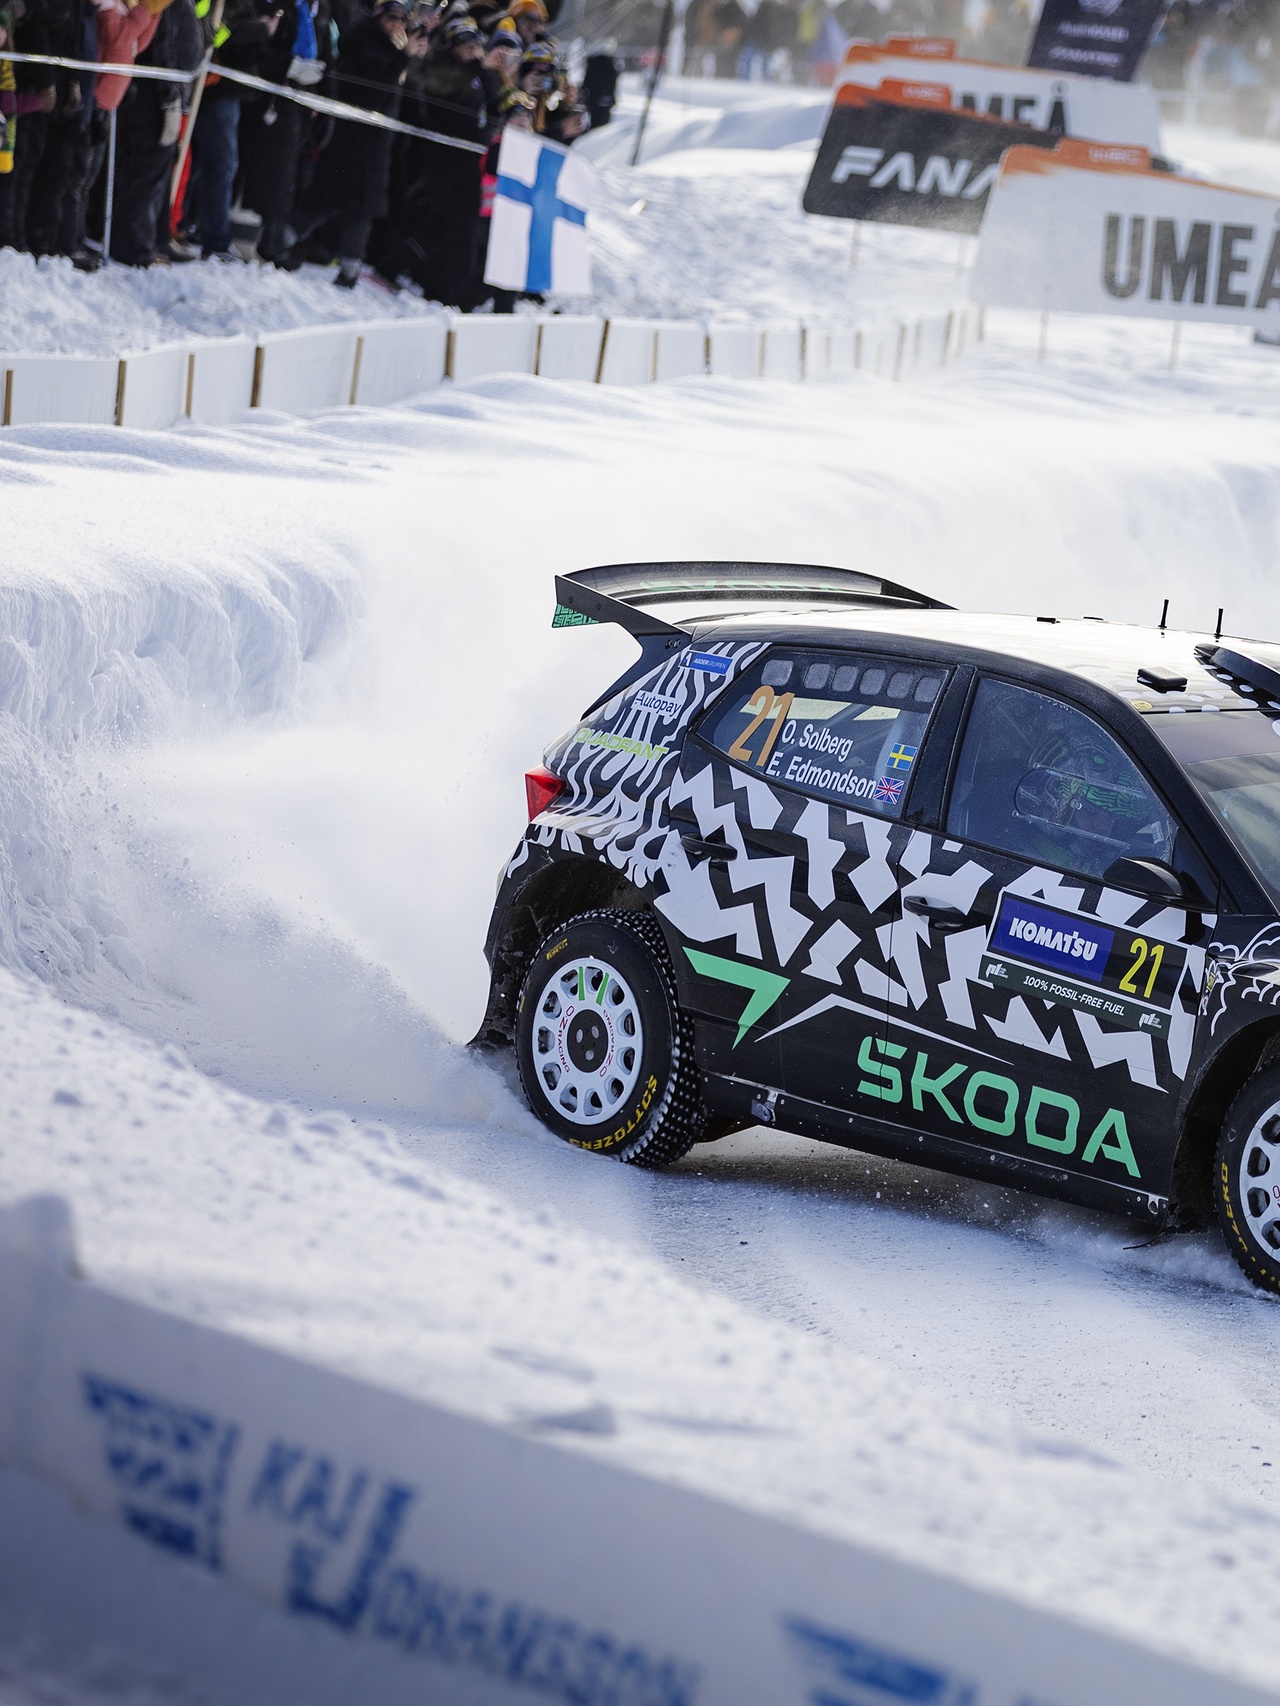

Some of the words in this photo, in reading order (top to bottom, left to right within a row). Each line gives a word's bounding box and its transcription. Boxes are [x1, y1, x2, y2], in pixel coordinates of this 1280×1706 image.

[635, 691, 682, 718] Autopay
[727, 685, 795, 768] 21
[573, 727, 670, 761] QUADRANT
[781, 719, 797, 745] O.
[799, 723, 854, 764] Solberg
[765, 751, 784, 778] E.
[785, 755, 878, 800] Edmondson
[1008, 917, 1099, 963] KOMATSU
[1118, 937, 1165, 999] 21
[1023, 975, 1049, 991] 100%
[1048, 984, 1104, 1010] FOSSIL-FREE
[1102, 1001, 1126, 1017] FUEL
